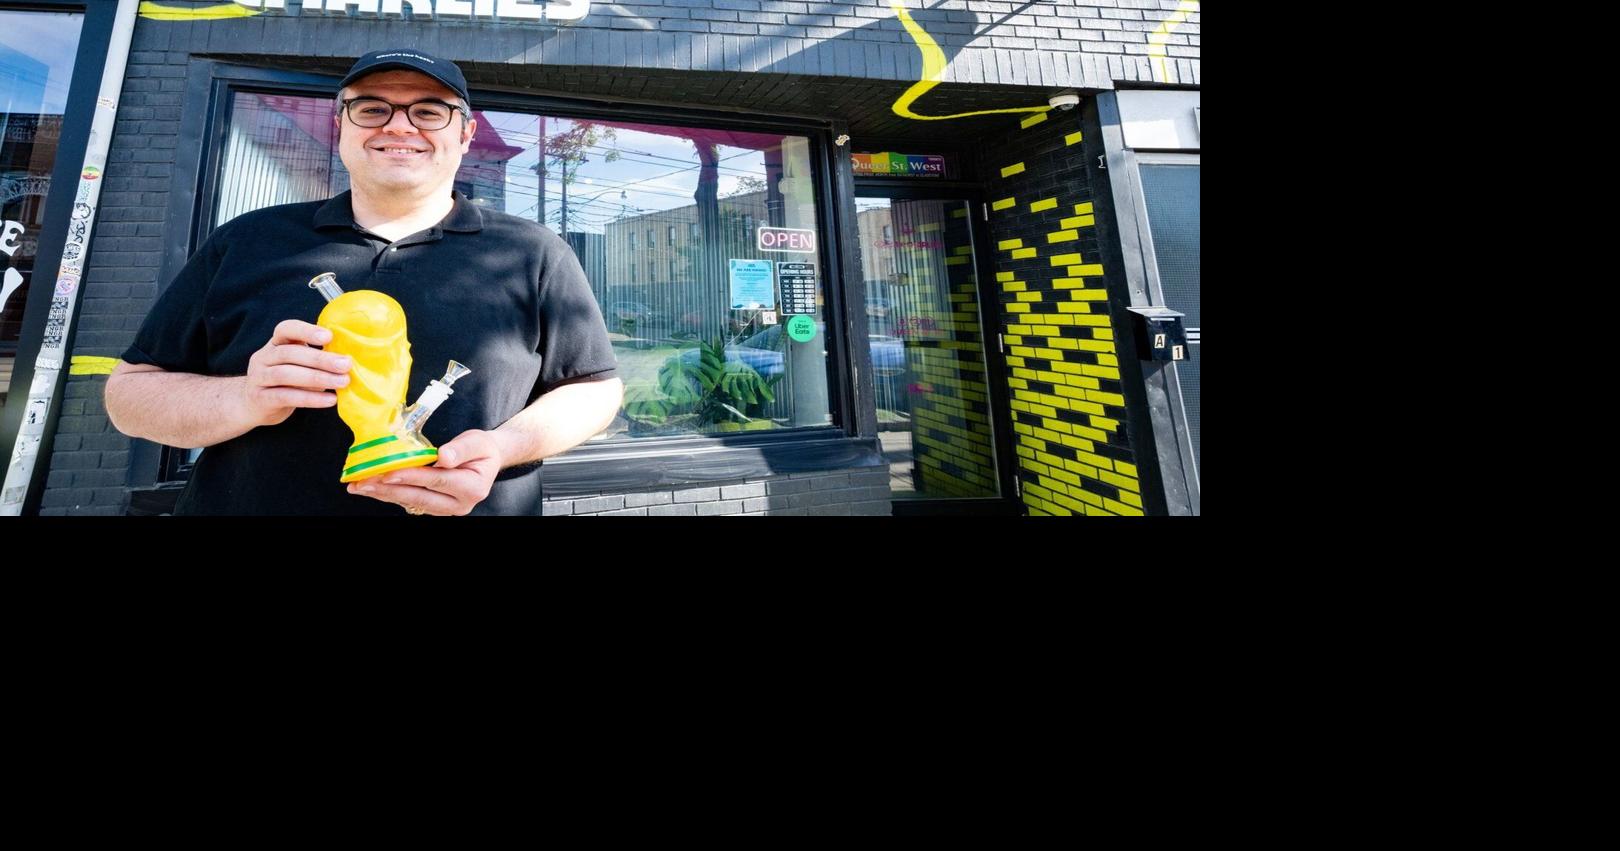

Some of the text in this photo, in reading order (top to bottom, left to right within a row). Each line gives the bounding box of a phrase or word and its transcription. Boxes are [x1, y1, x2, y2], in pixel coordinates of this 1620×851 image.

[892, 161, 907, 170] St.
[910, 162, 941, 171] West
[761, 232, 812, 249] OPEN
